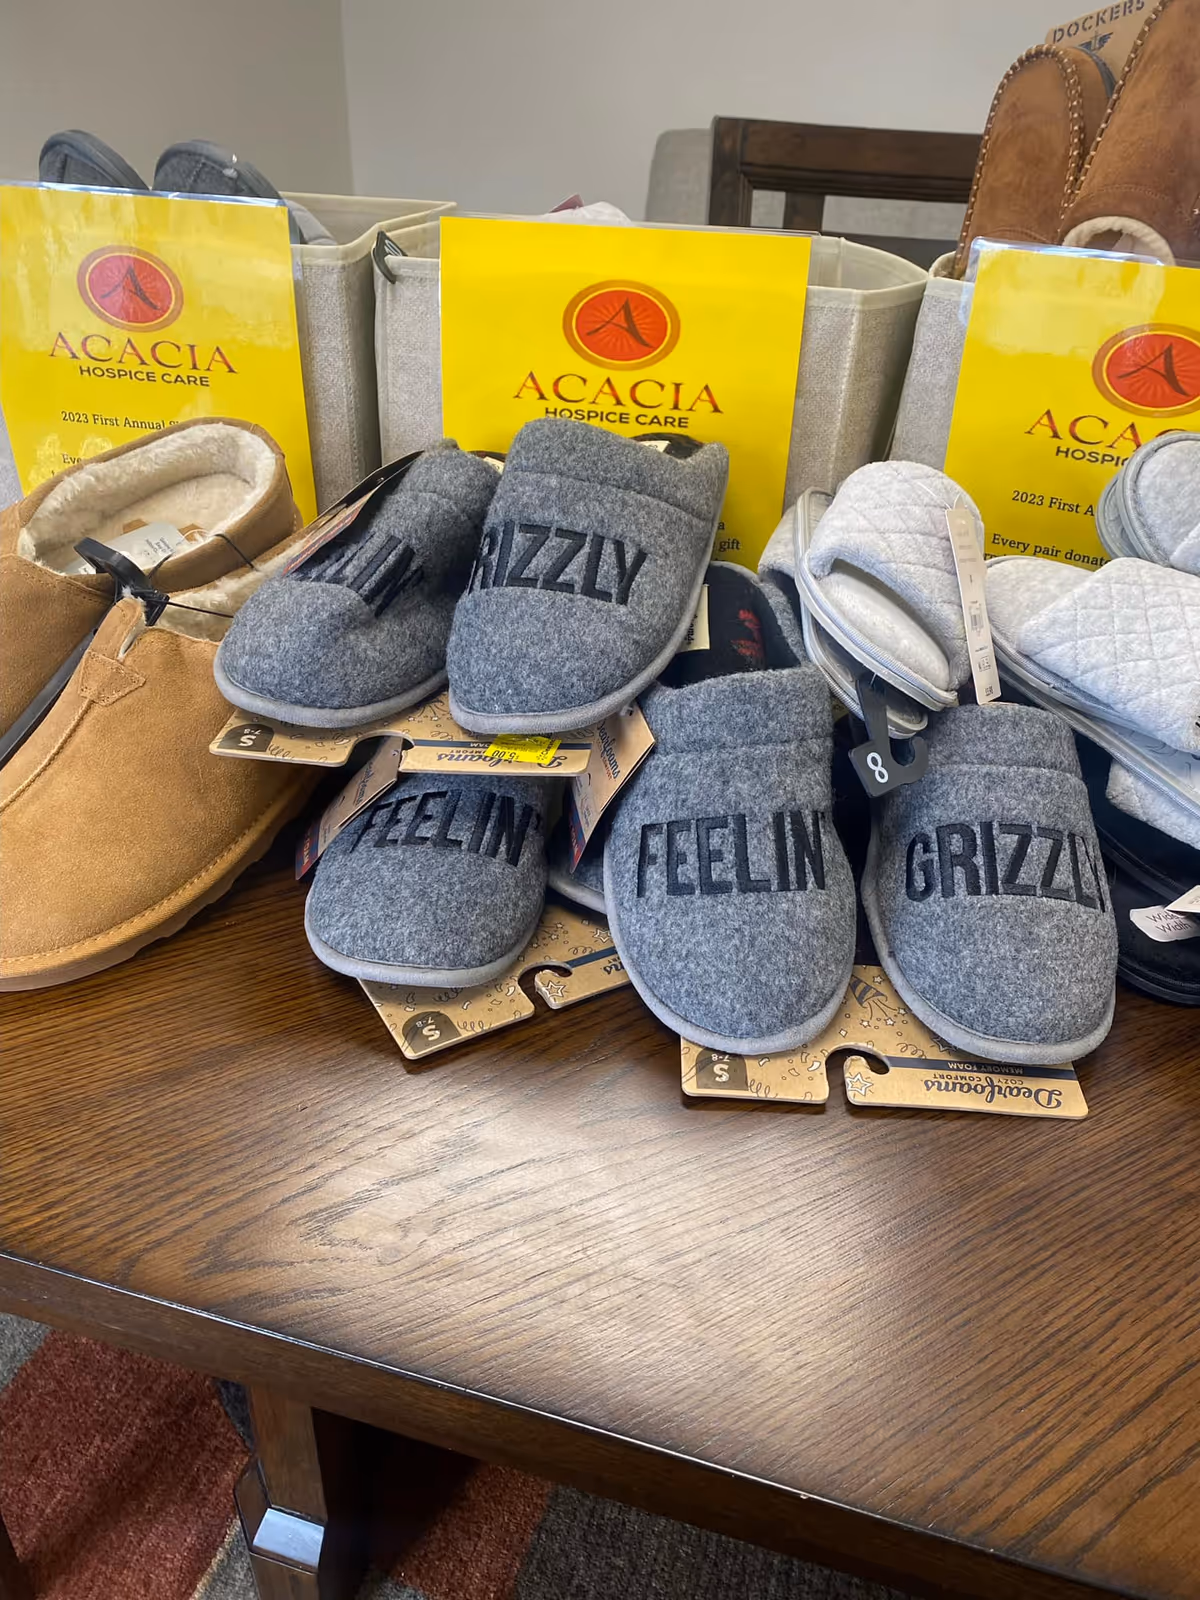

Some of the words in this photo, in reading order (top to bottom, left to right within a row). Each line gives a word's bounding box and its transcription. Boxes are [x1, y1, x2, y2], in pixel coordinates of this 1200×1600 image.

[1053, 0, 1145, 44] DOCKERS
[48, 331, 238, 374] ACACIA
[79, 365, 157, 382] HOSPICE
[161, 373, 210, 387] CARE
[513, 370, 724, 413] ACACIA
[61, 410, 89, 424] 2023
[92, 413, 120, 427] First
[123, 416, 165, 430] Annual
[545, 407, 630, 424] HOSPICE
[635, 414, 689, 428] CARE
[1024, 408, 1187, 452] ACA
[1055, 446, 1130, 467] HOSPI
[1012, 490, 1045, 506] 2023
[1048, 496, 1080, 514] First
[719, 538, 741, 552] gift
[991, 533, 1030, 553] Every
[1033, 543, 1062, 557] pair
[467, 519, 648, 606] RIZZLY
[237, 734, 257, 747] S
[866, 752, 889, 784] 8
[415, 1016, 434, 1028] 7-8
[422, 1024, 441, 1041] S
[711, 1053, 730, 1062] 7-8
[947, 1061, 979, 1071] FOAM
[713, 1063, 730, 1083] S
[933, 1072, 982, 1082] COMFORT
[980, 1065, 1024, 1075] MEMORY
[923, 1075, 1063, 1109] Dearfoams
[997, 1078, 1024, 1086] COZY
